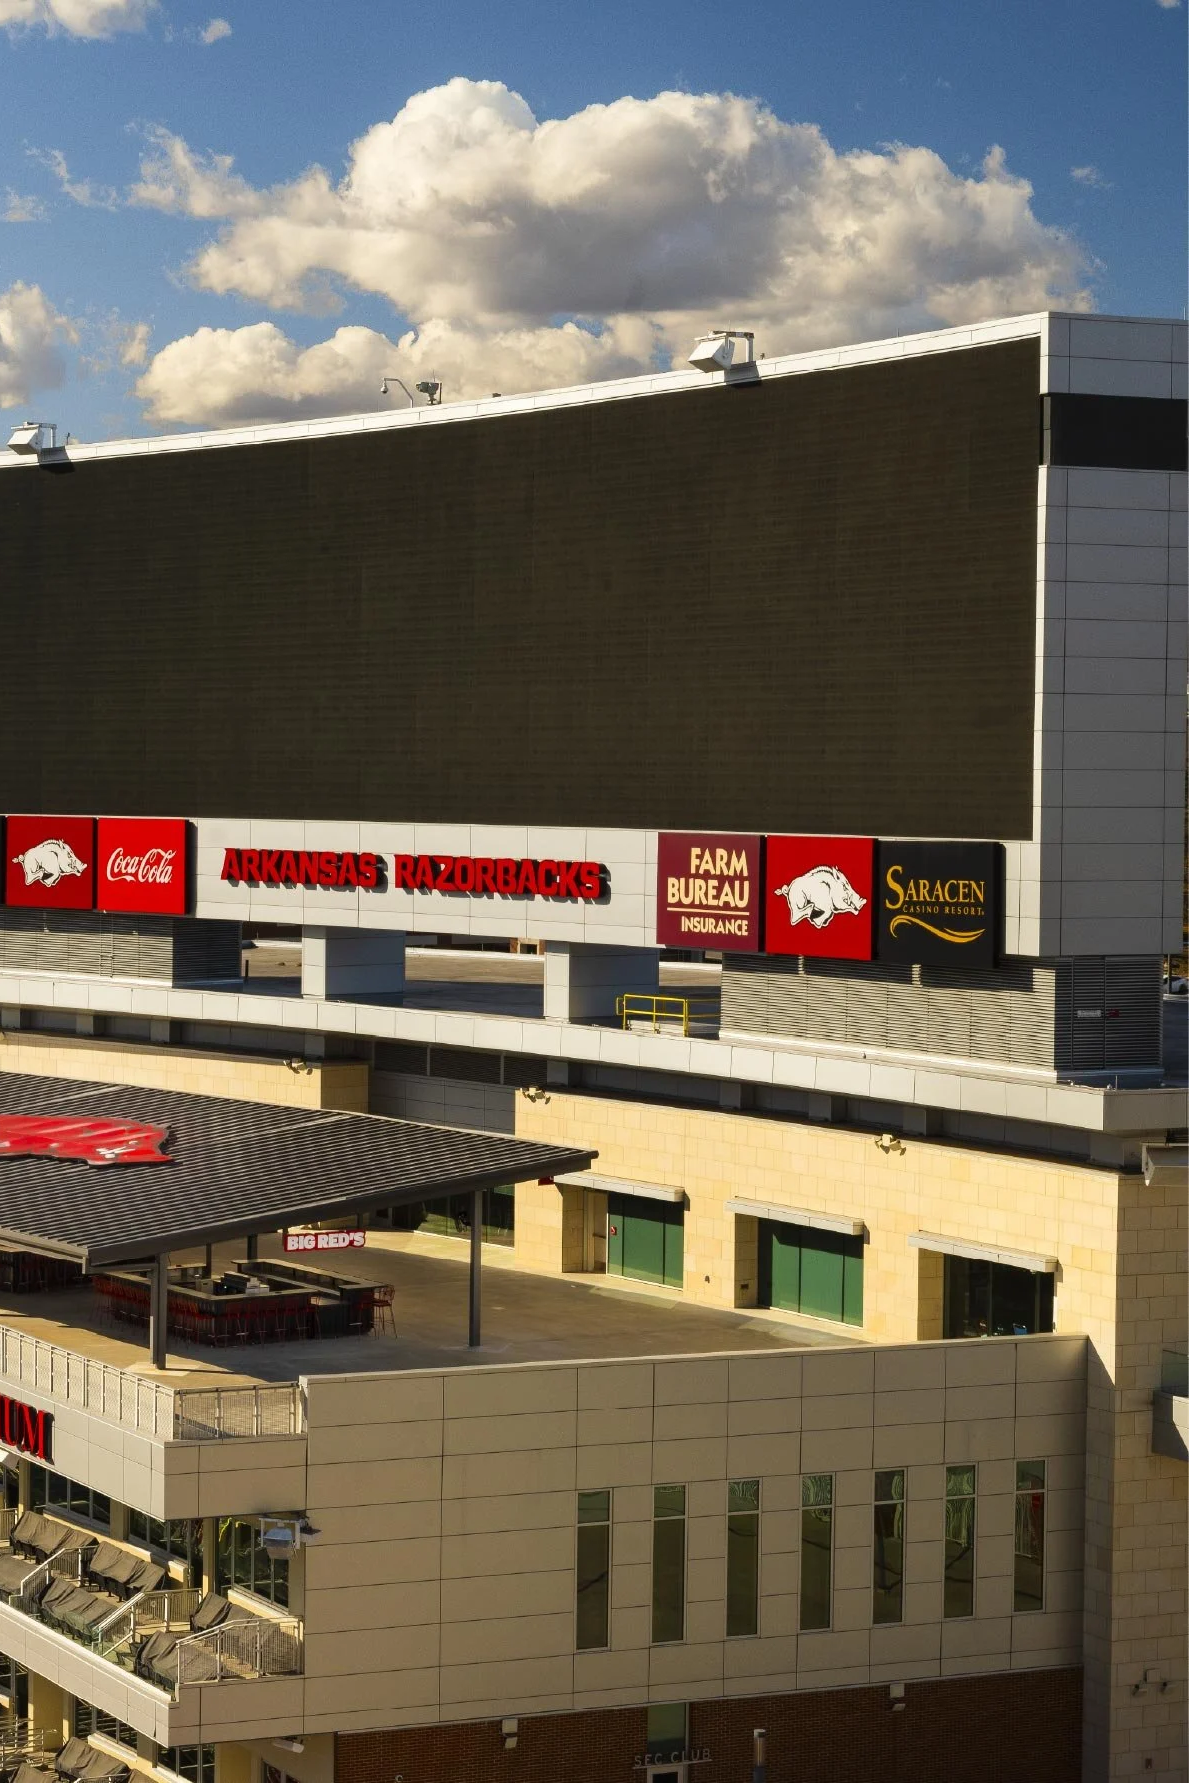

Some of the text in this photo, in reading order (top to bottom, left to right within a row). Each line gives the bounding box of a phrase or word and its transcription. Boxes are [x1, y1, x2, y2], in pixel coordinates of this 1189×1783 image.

[106, 847, 177, 884] Coca-Cola
[220, 847, 601, 899] ARKANSAS RAZORBACKS
[690, 847, 749, 877] FARM
[667, 877, 750, 908] BUREAU
[885, 865, 985, 910] SARACEN
[902, 904, 982, 916] CASINO RESORT
[681, 915, 749, 936] INSURANCE
[287, 1232, 365, 1250] BIG RED'S
[634, 1749, 710, 1767] SEC CLUB
